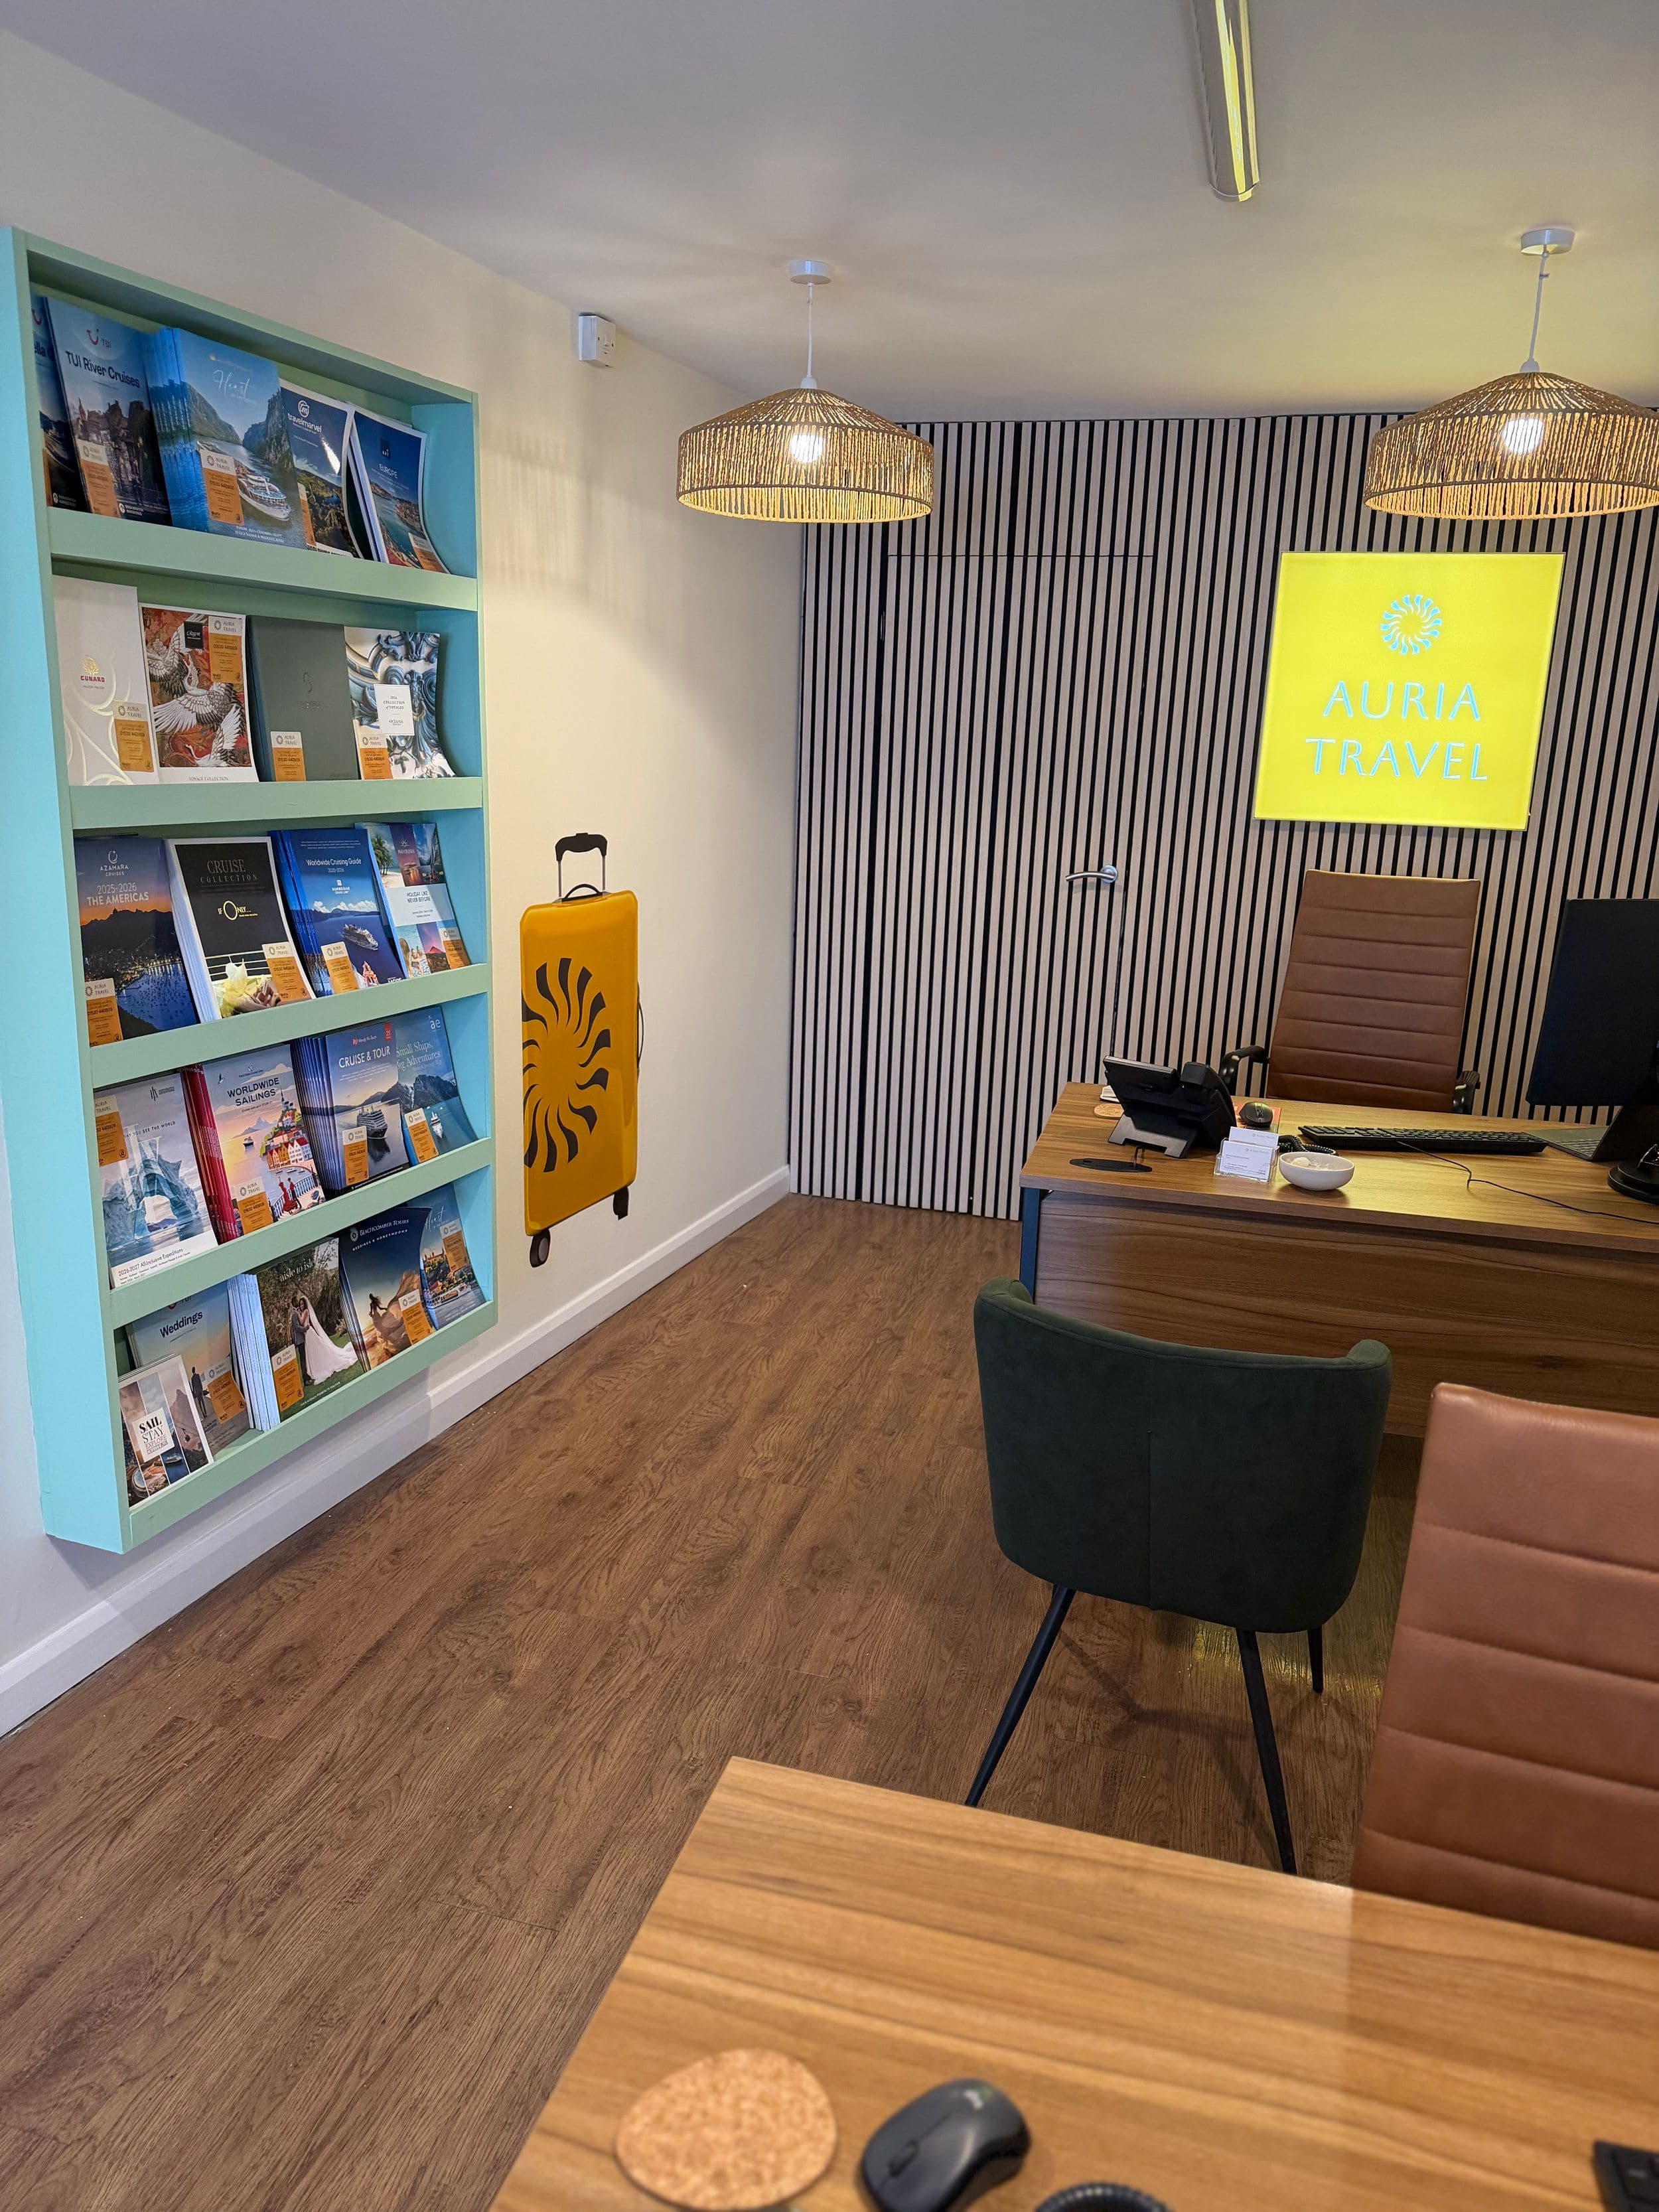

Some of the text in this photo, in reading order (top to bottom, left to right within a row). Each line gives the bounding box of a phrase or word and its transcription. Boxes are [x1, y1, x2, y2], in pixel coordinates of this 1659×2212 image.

[66, 350, 82, 367] TUI
[83, 357, 107, 376] River
[108, 366, 140, 388] Cruises
[287, 413, 322, 433] travelmarvel
[379, 464, 398, 479] EUROPE
[1322, 680, 1480, 721] AURIA
[1305, 738, 1488, 780] TRAVEL
[207, 859, 246, 874] CRUISE
[200, 874, 258, 884] COLLECTION
[97, 882, 137, 895] 2025-2026
[87, 892, 149, 907] THE AMERICAS
[431, 1019, 441, 1029] ae
[414, 1040, 434, 1053] Ships,
[338, 1045, 391, 1069] CRUISE & TOUR
[406, 1051, 441, 1068] Adventures
[227, 1077, 280, 1098] WORLDWIDE
[236, 1088, 276, 1106] SAILINGS
[359, 1222, 392, 1236] BEACHCOMBER
[352, 1240, 371, 1252] WEDDINGS
[376, 1228, 408, 1241] HONEYMOONS
[140, 1256, 163, 1268] All-Inclusive
[162, 1248, 184, 1260] Expeditions
[296, 1266, 303, 1274] to
[159, 1311, 203, 1339] Weddings
[139, 1416, 162, 1434] SAIL
[142, 1425, 164, 1444] STAY
[145, 1434, 167, 1448] EXPLORE
